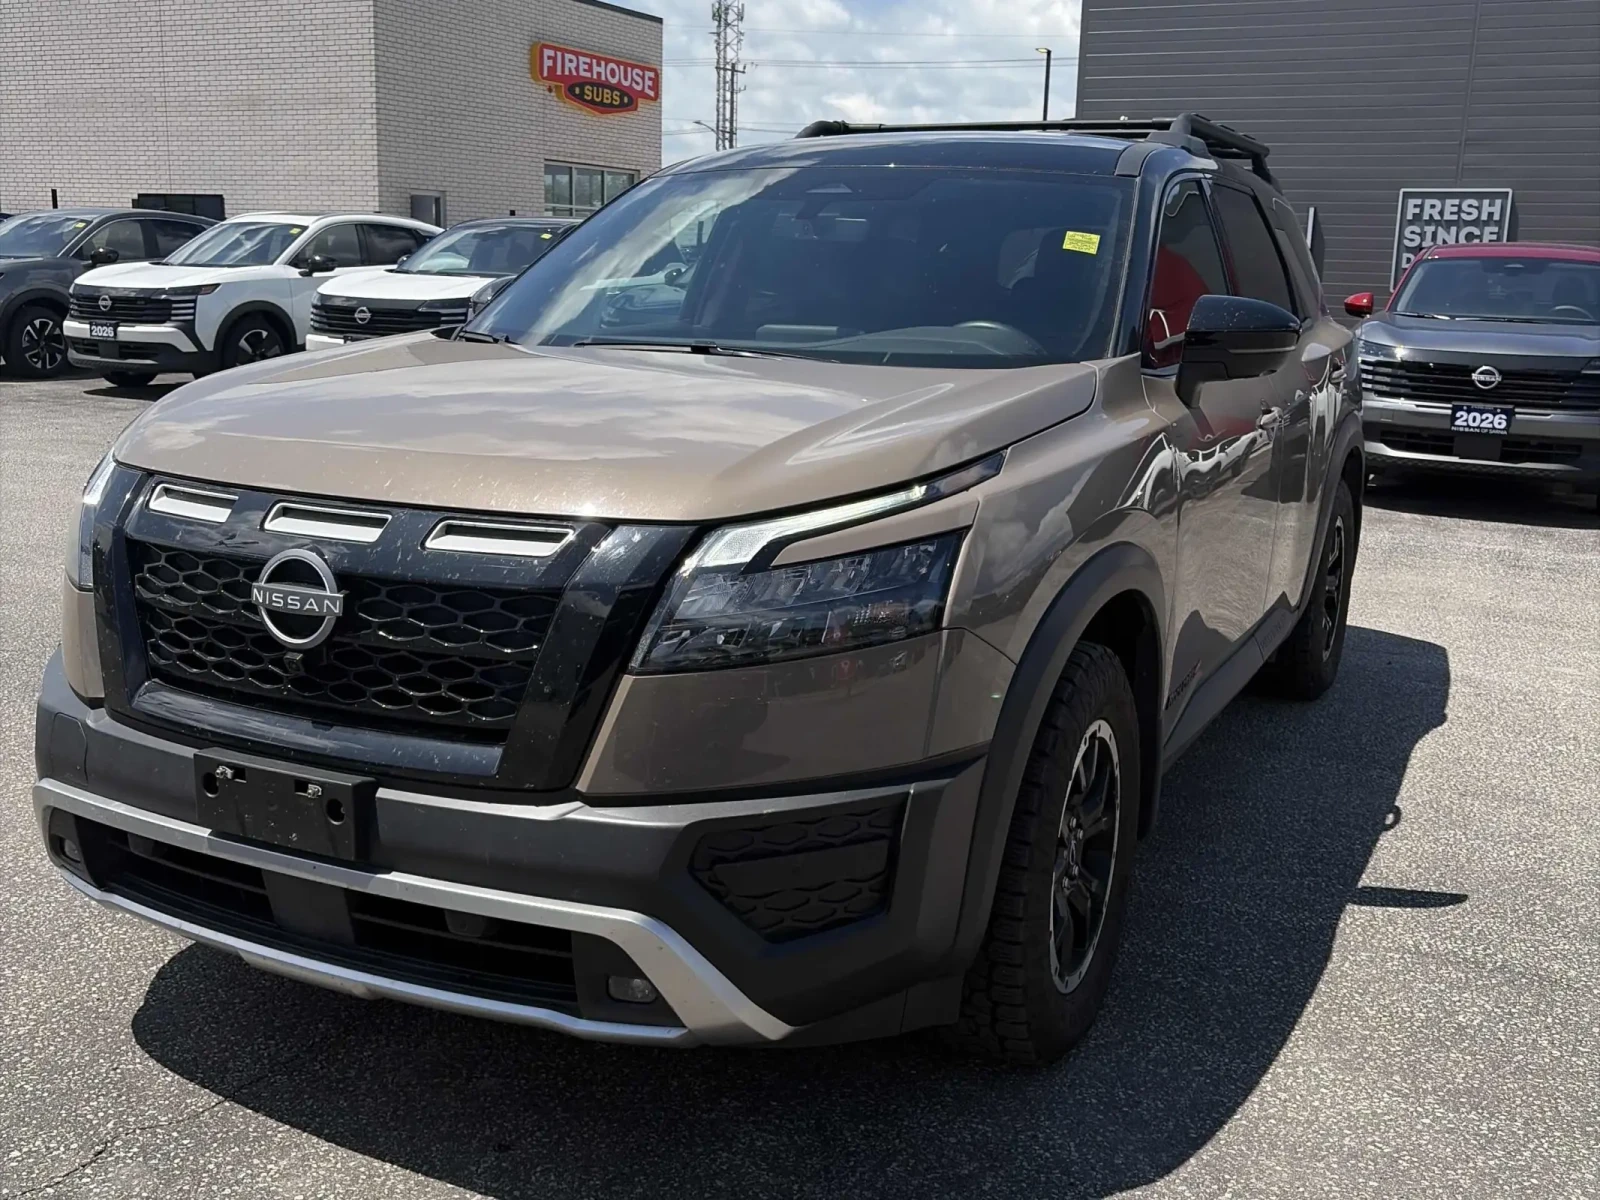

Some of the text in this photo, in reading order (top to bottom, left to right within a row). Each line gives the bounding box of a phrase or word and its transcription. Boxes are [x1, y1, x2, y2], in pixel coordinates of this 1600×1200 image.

[543, 48, 655, 98] FIREHOUSE
[584, 85, 620, 105] SUBS
[1406, 198, 1502, 221] FRESH
[1403, 225, 1499, 248] SINCE
[91, 325, 115, 337] 2026
[1454, 411, 1507, 429] 2026
[252, 588, 340, 613] NISSAN
